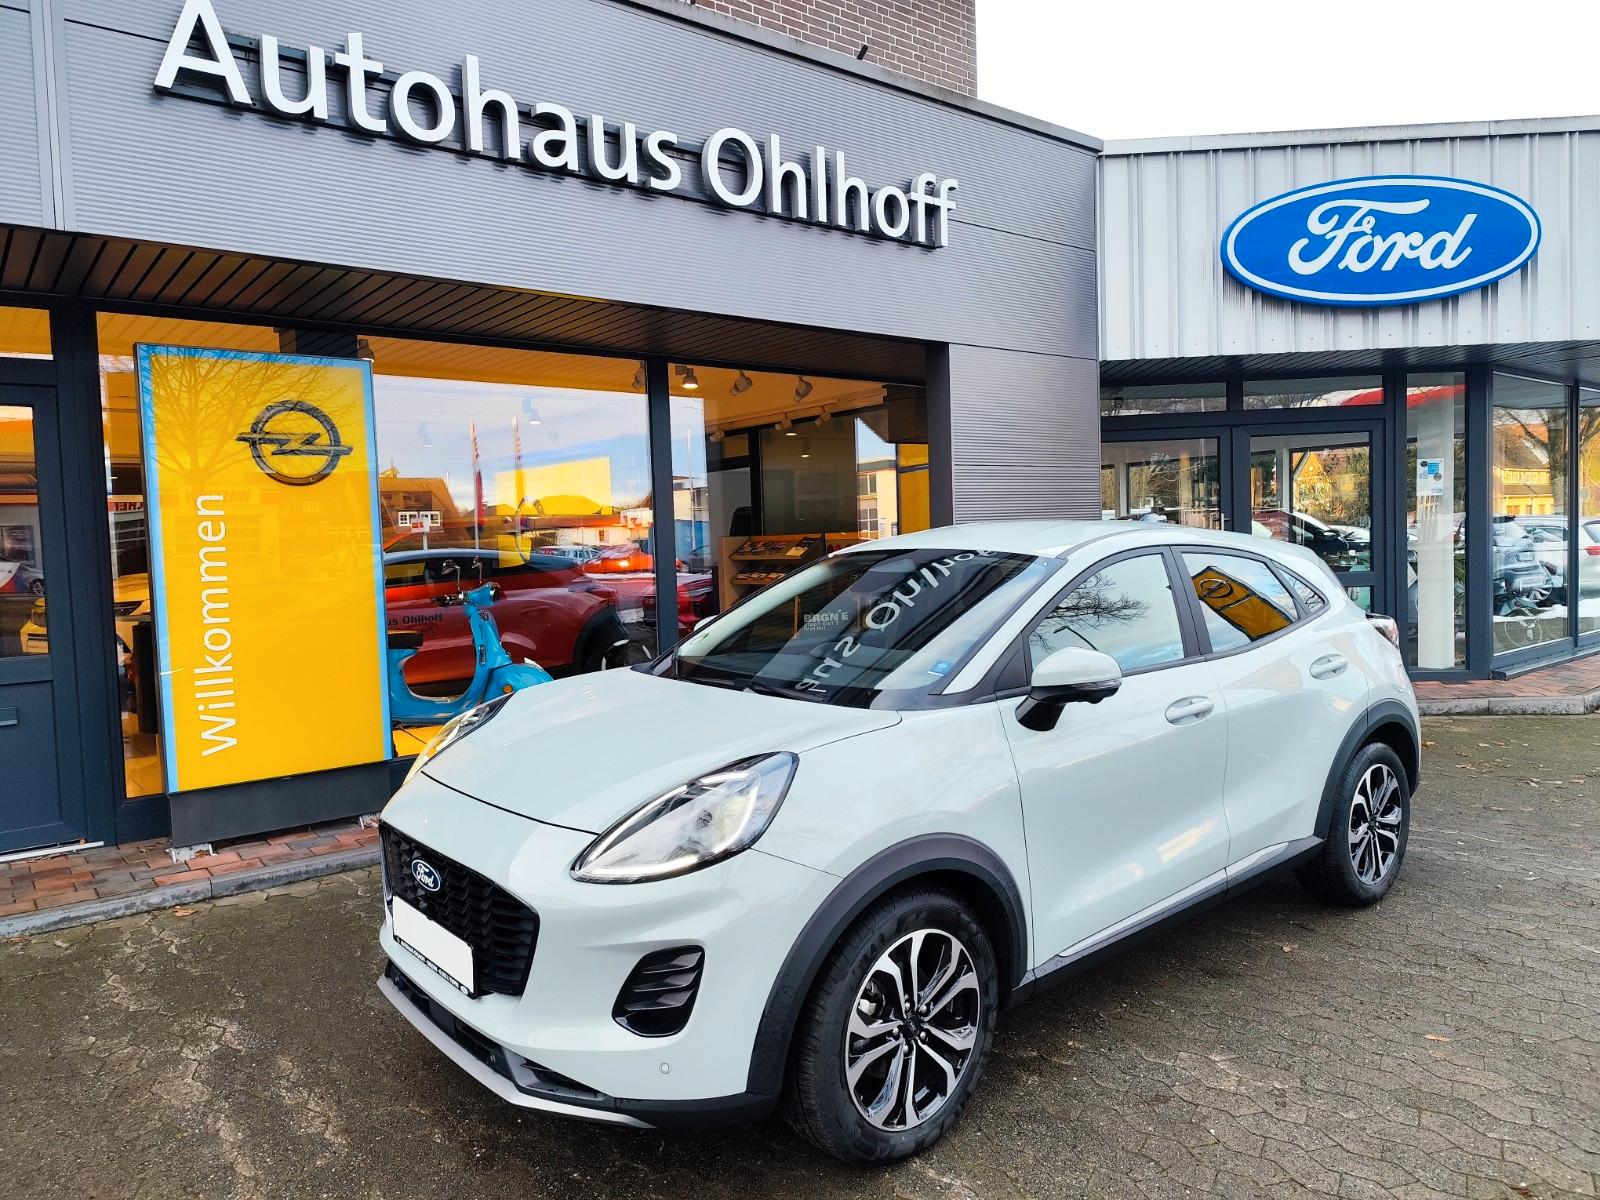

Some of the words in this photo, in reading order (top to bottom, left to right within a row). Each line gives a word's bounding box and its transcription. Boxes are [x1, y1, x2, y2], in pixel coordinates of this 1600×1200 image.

[154, 0, 683, 191] Autohaus
[702, 128, 958, 247] Ohlhoff
[1288, 199, 1478, 275] Ford
[194, 494, 238, 757] Willkommen
[402, 612, 442, 624] Ohlhoff
[416, 863, 435, 888] Ford
